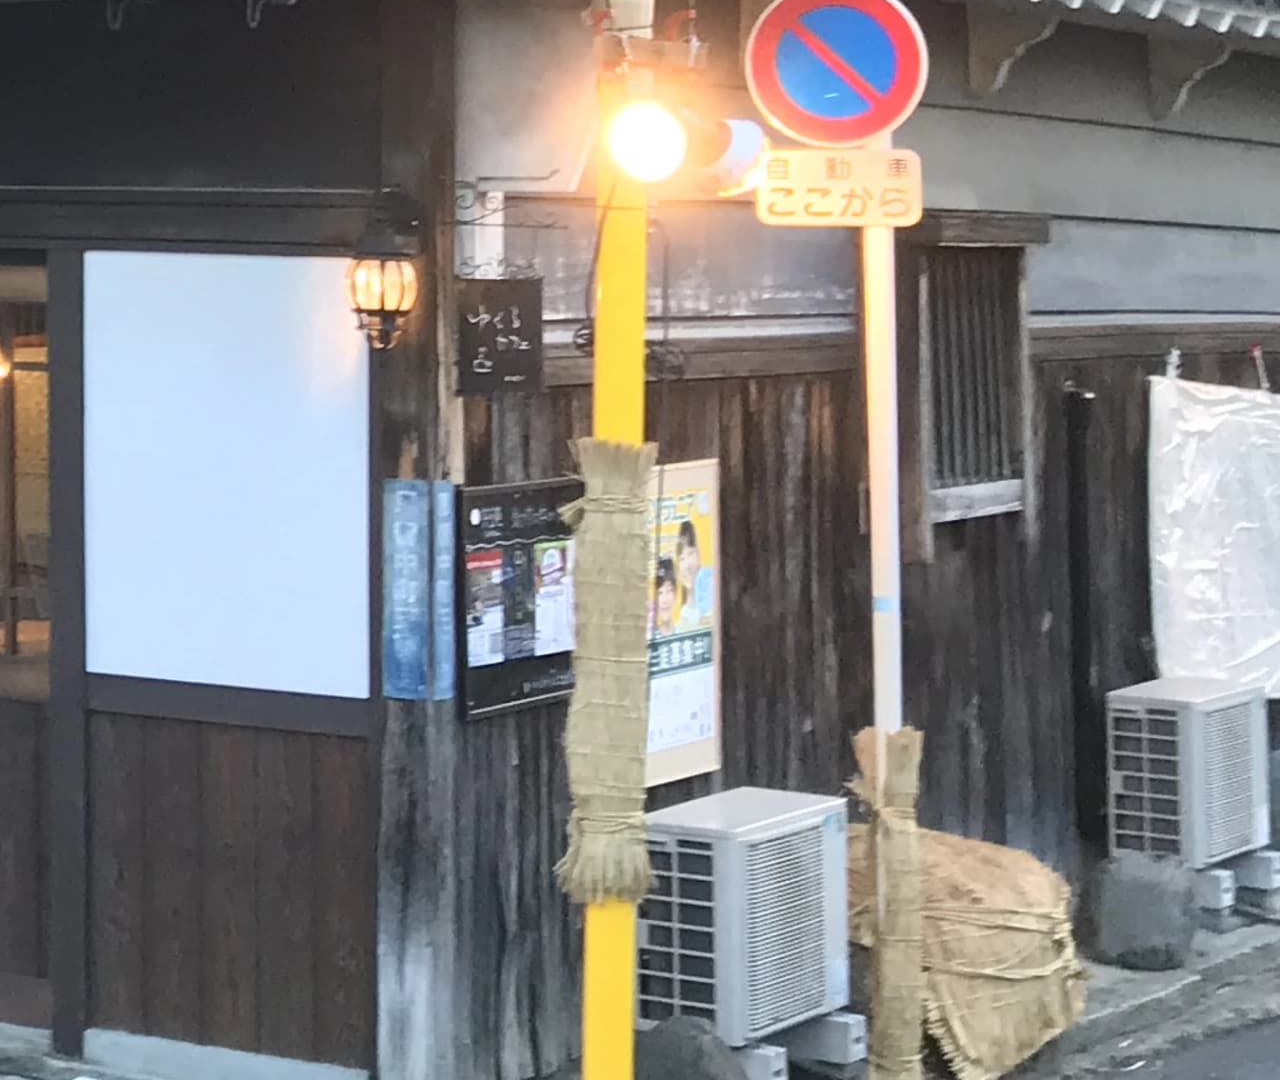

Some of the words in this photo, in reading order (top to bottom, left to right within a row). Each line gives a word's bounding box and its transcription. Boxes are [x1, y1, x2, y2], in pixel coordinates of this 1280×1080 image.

[767, 157, 911, 180] 自動車
[767, 186, 913, 218] ここから
